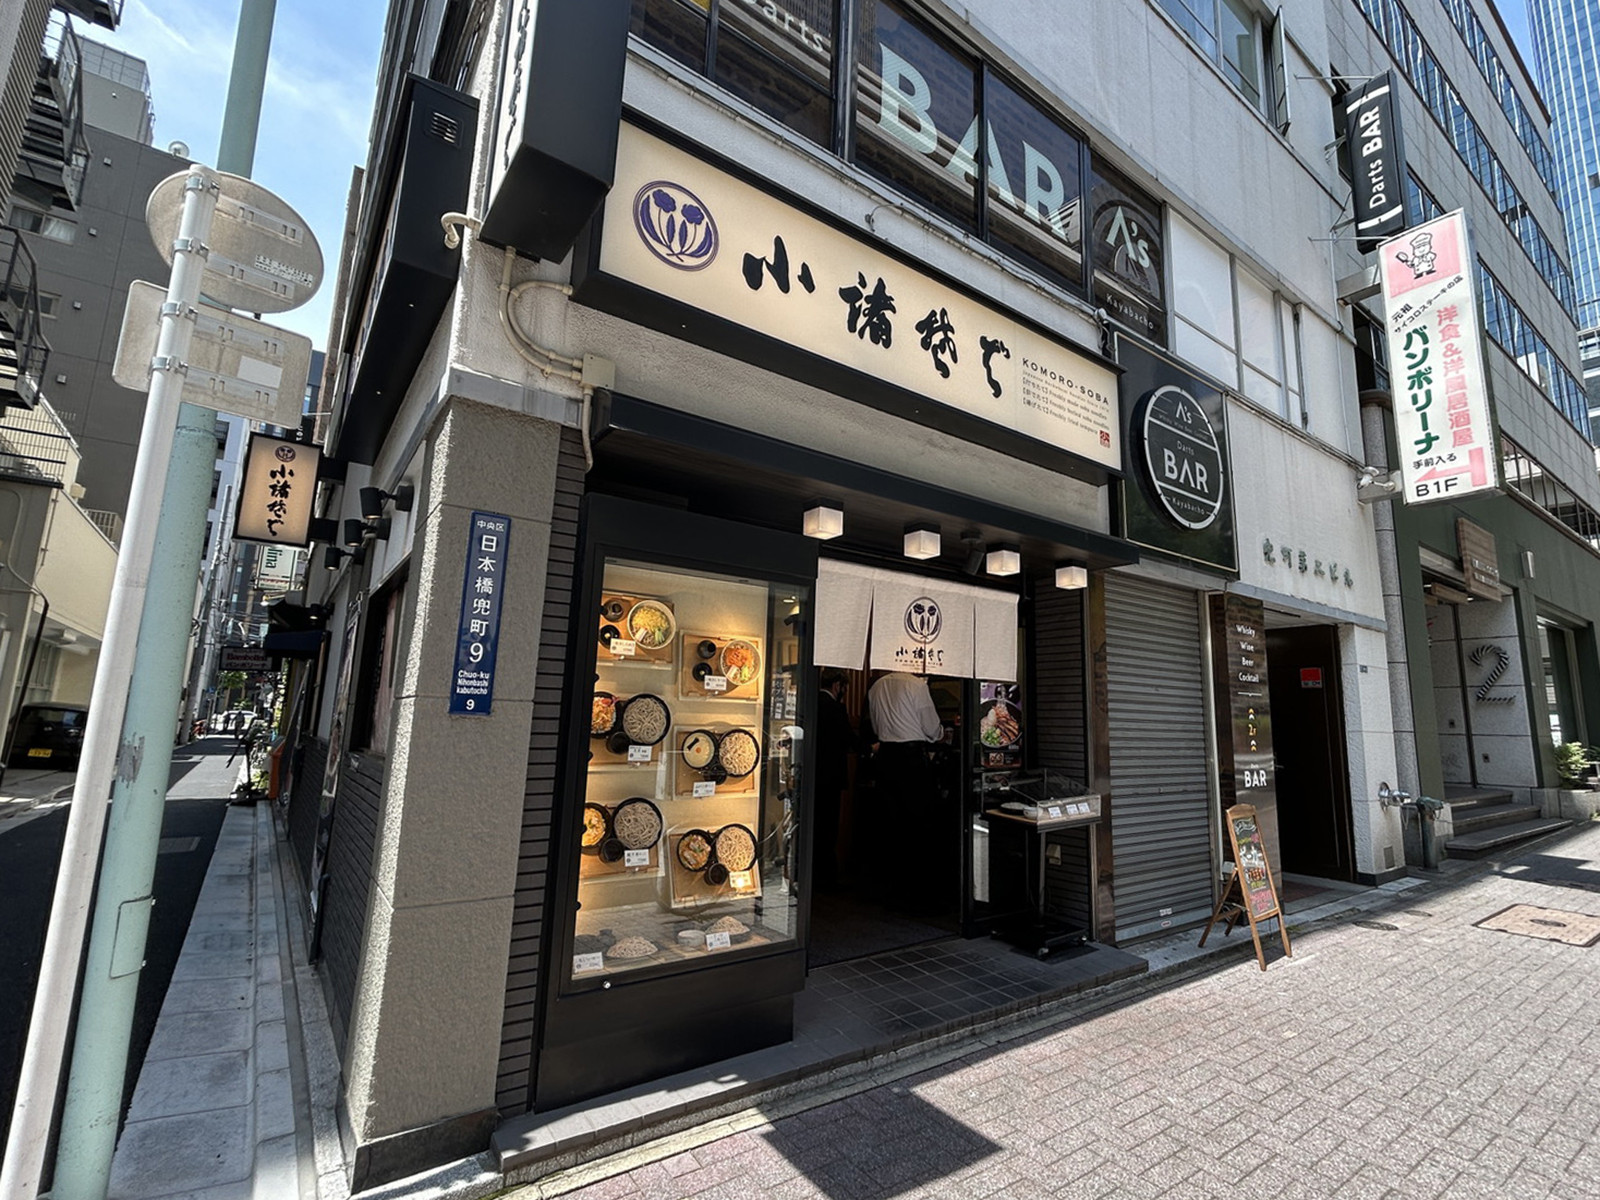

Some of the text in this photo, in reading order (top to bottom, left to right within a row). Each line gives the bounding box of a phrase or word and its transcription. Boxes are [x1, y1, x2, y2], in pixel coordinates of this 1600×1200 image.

[743, 0, 823, 52] arts
[876, 42, 1069, 243] BAR
[1359, 106, 1386, 209] Darts BAR
[1105, 293, 1154, 330] Kayabacho
[1403, 324, 1440, 456] バンボリーナ
[1412, 452, 1457, 470] 手前入る
[1163, 448, 1209, 494] BAR
[1415, 477, 1459, 497] B1F
[1172, 497, 1205, 516] Kayabacho
[477, 520, 504, 532] 中央区
[1235, 624, 1256, 638] Whisky
[1240, 641, 1254, 652] Wine
[1241, 656, 1254, 667] Beer
[458, 669, 490, 680] Chuo-ku
[1238, 671, 1260, 683] Cocktail
[465, 698, 475, 710] 9
[1244, 769, 1267, 788] BAR
